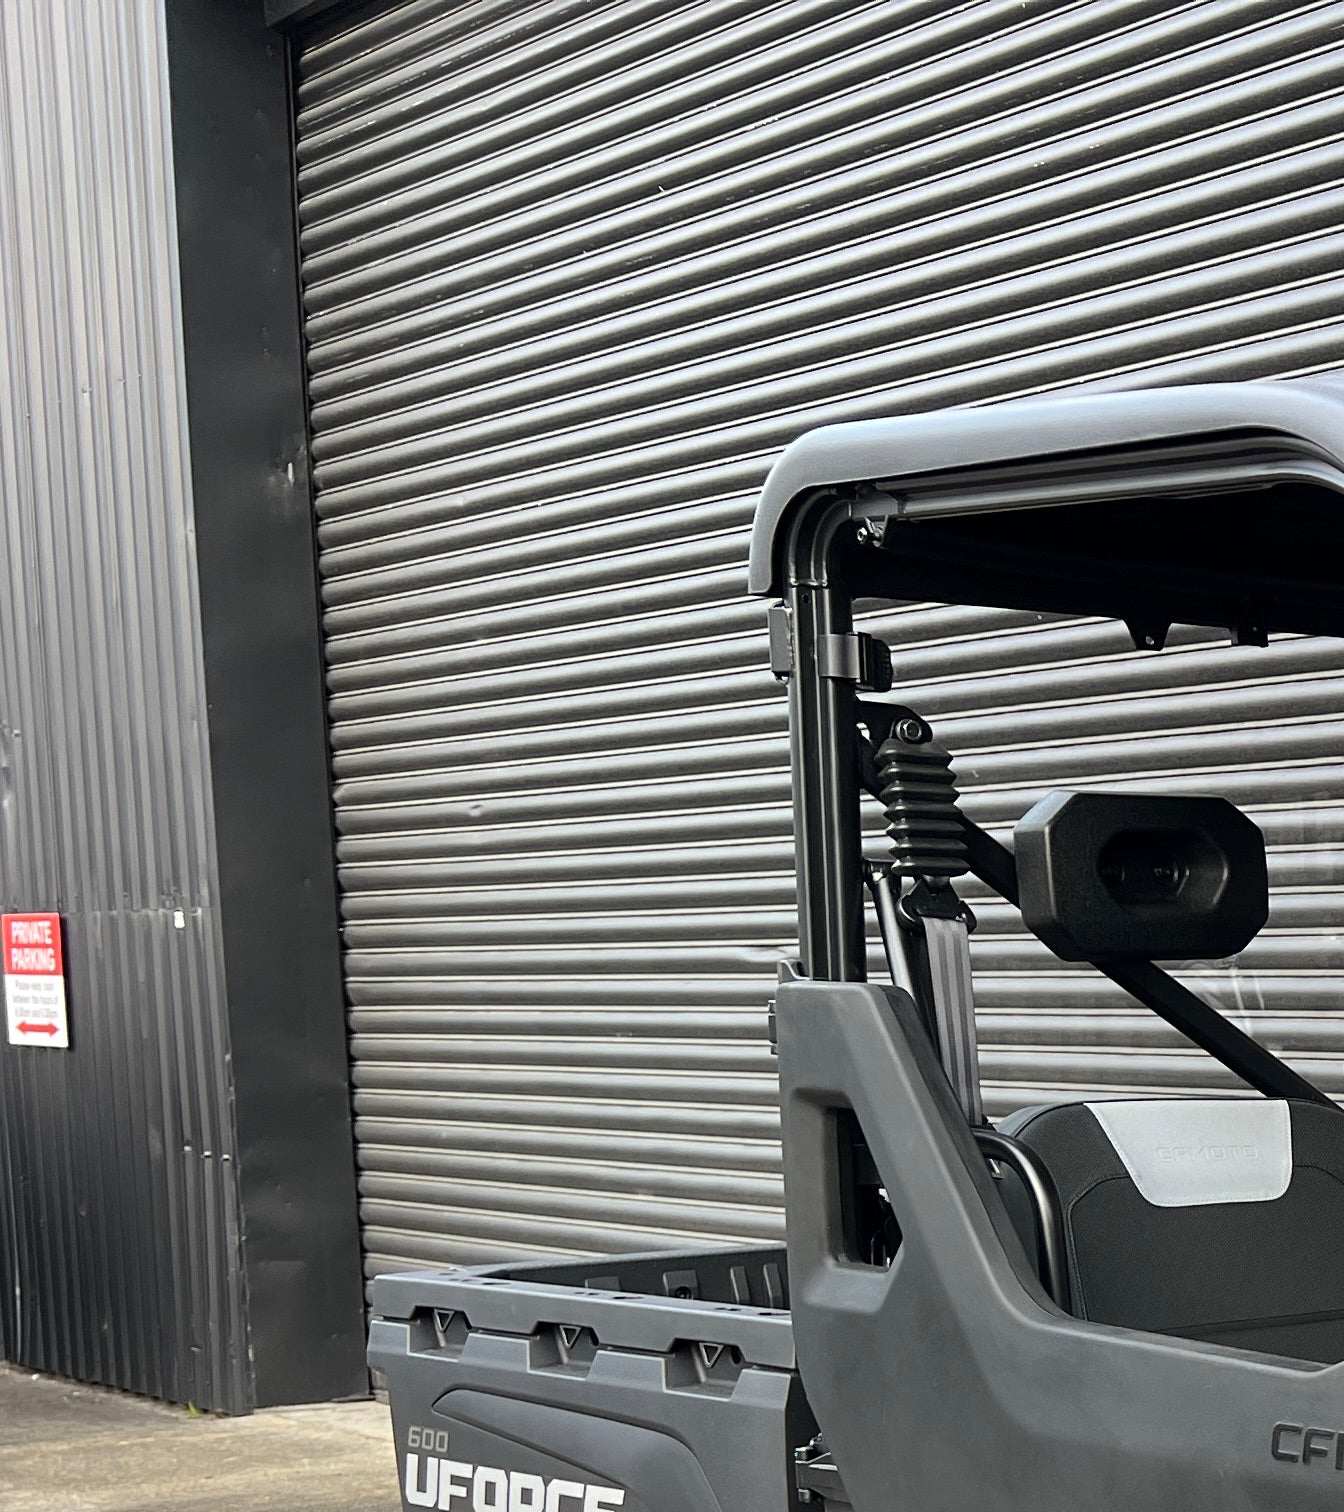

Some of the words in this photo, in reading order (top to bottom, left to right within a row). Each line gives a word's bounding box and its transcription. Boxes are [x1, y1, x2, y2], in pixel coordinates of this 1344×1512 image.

[11, 920, 52, 945] PRIVATE
[11, 947, 56, 971] PARKING
[407, 1426, 449, 1453] 600
